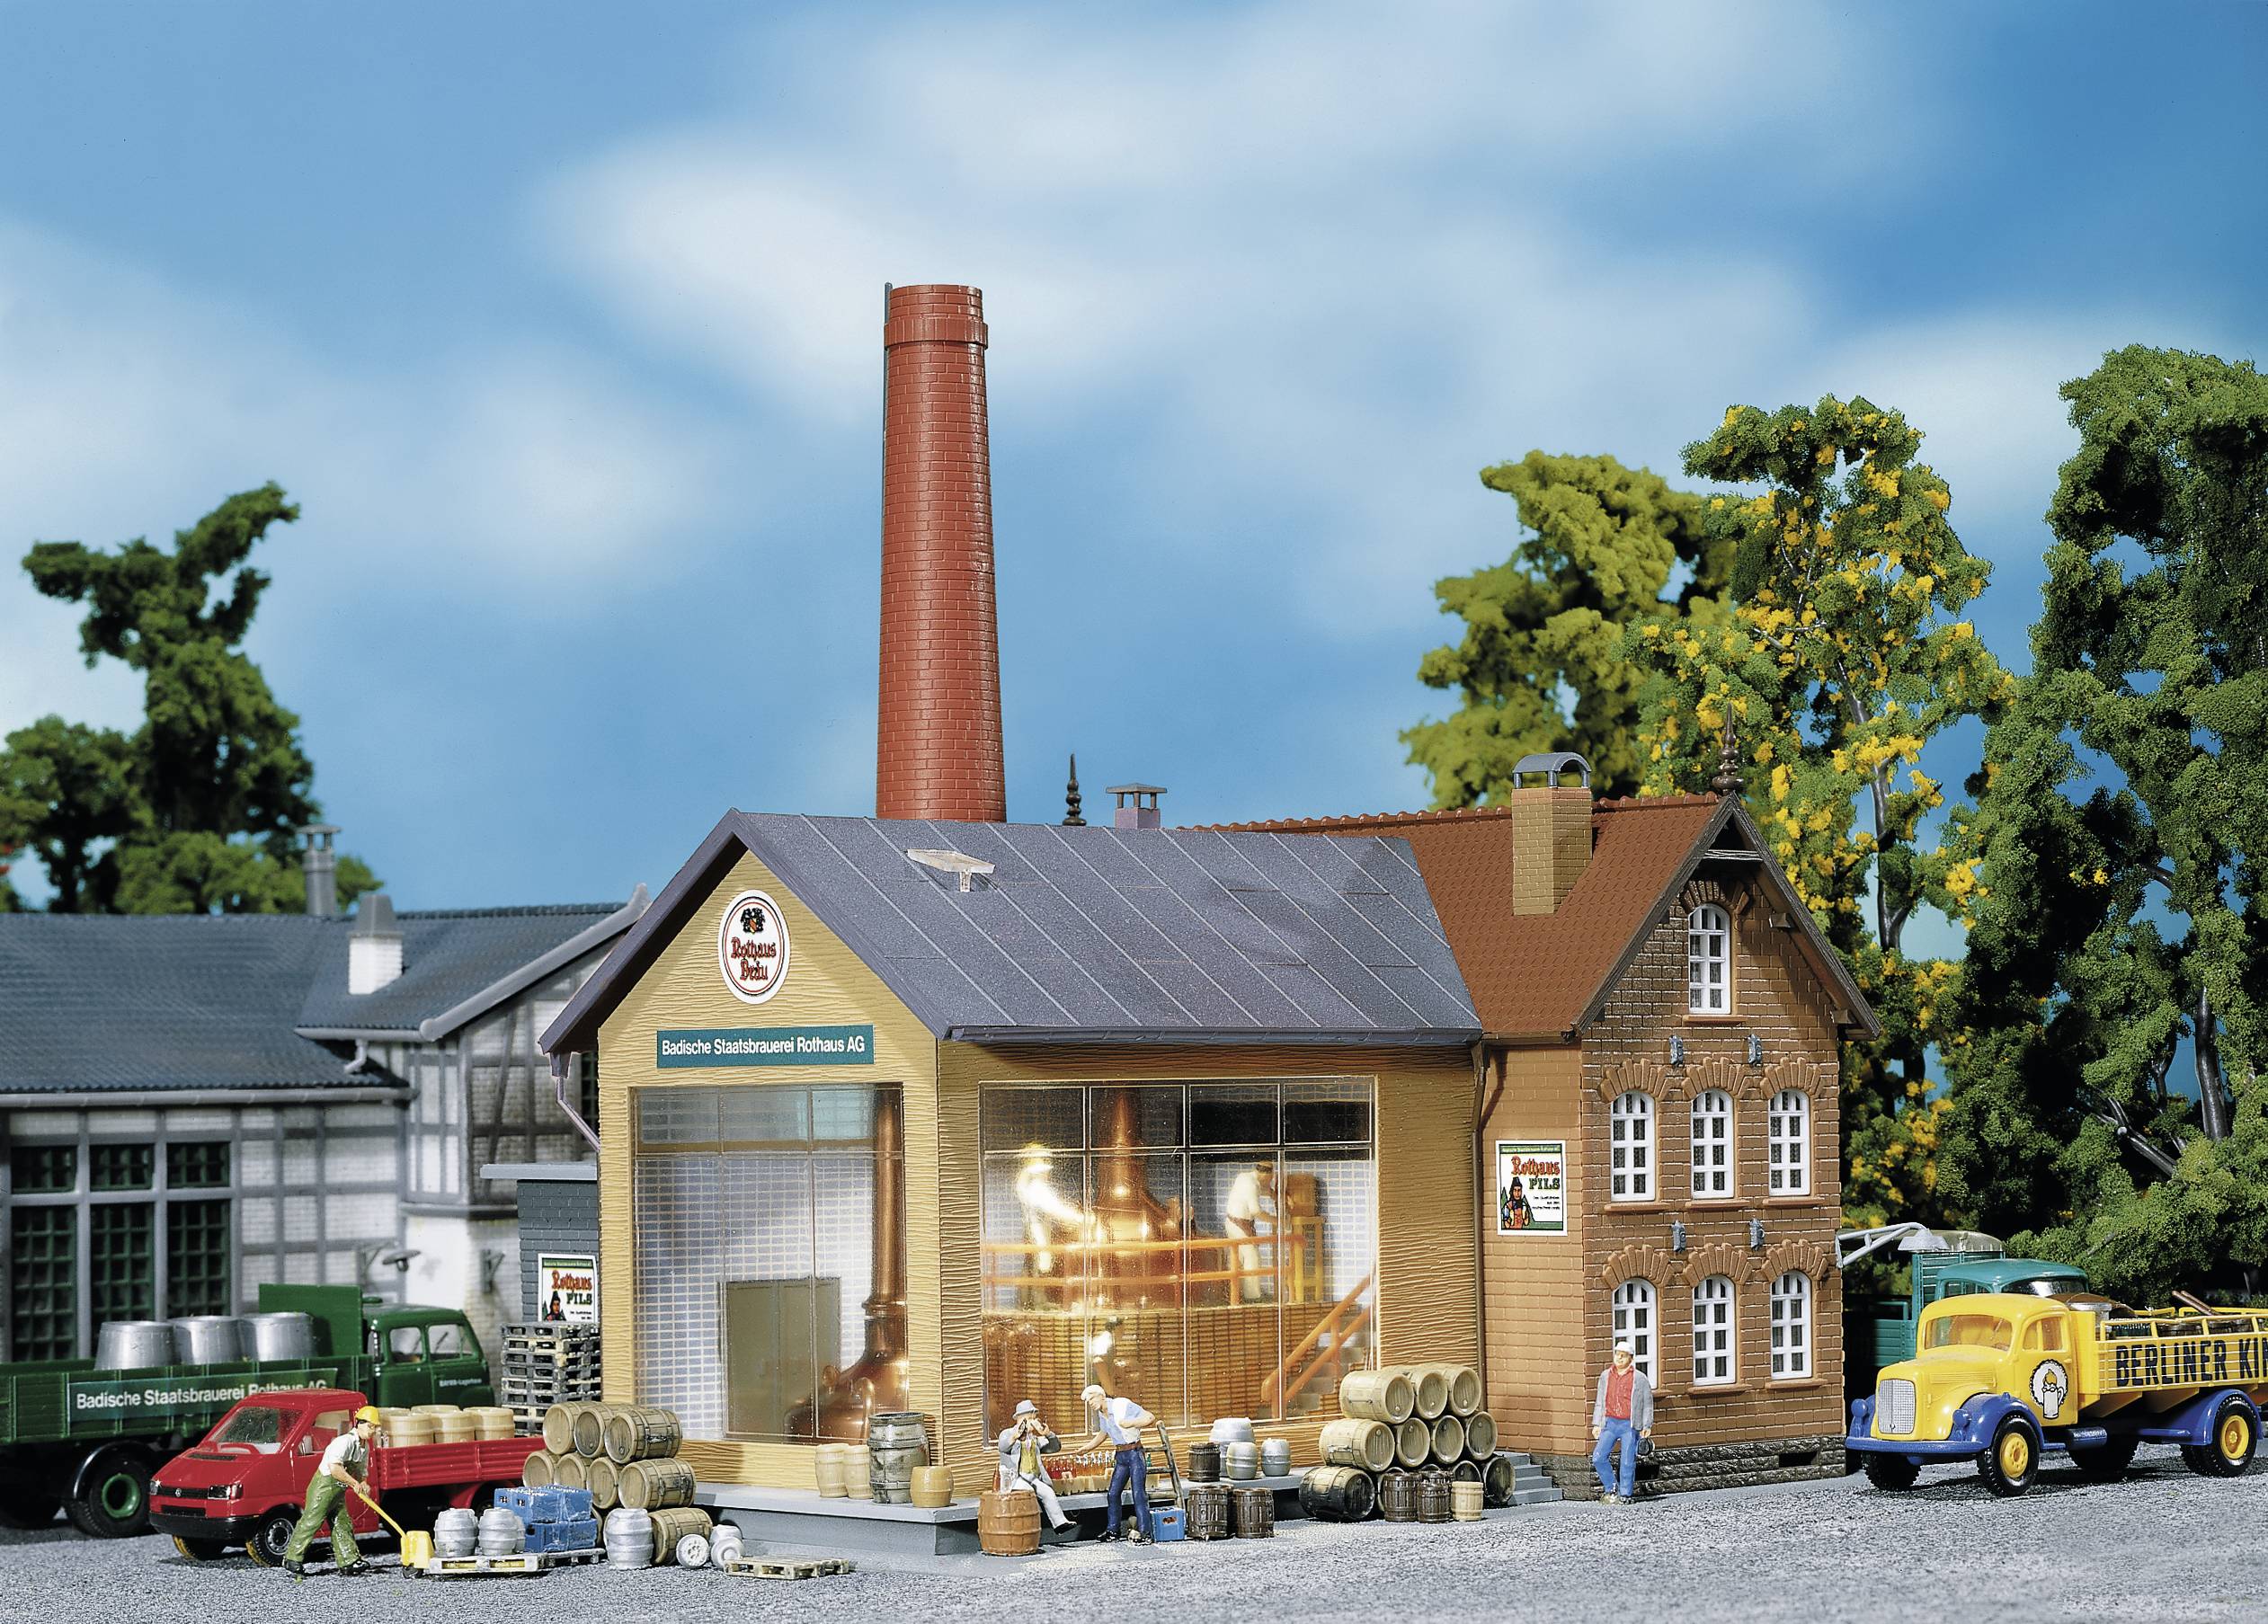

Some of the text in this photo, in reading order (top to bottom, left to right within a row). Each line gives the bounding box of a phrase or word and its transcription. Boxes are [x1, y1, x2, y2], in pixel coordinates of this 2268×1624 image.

[731, 936, 777, 961] Rothaus
[662, 1035, 865, 1055] Badische Staatsbrauerei Rothaus AG
[1511, 1156, 1561, 1176] Rothaus
[1528, 1177, 1561, 1190] PILS
[551, 1270, 592, 1291] Rothaus
[566, 1292, 592, 1306] PILS
[2115, 1339, 2228, 1387] BERLINER
[76, 1391, 141, 1409] Badische
[144, 1384, 245, 1406] Staatsbrauerei
